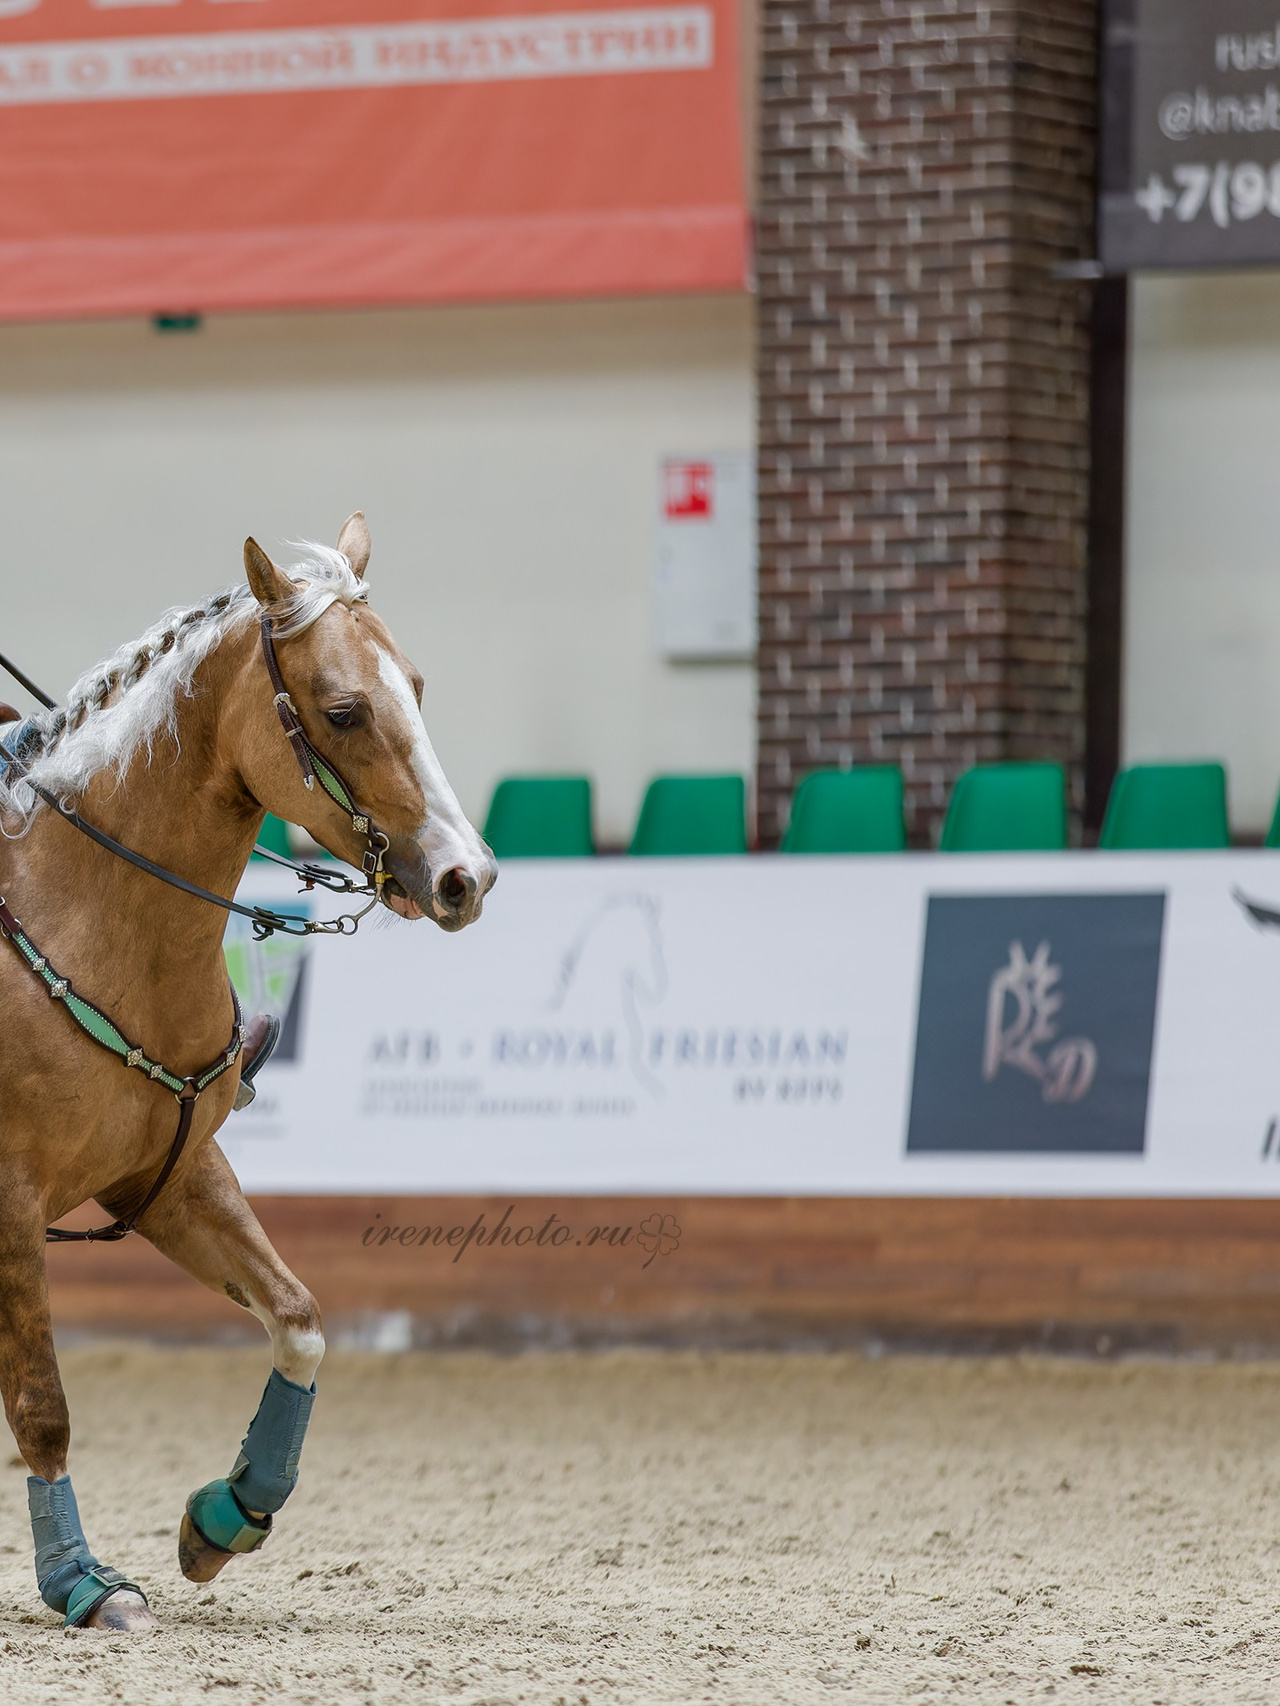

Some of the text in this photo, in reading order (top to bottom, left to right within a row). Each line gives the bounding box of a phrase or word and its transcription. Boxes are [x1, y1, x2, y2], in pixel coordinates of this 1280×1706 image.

[65, 51, 110, 90] О
[128, 34, 355, 81] КОННОЙ
[373, 20, 701, 73] ИНДУСТРИИ
[490, 1028, 617, 1069] ROYAL
[649, 1026, 849, 1068] FRIESIAN
